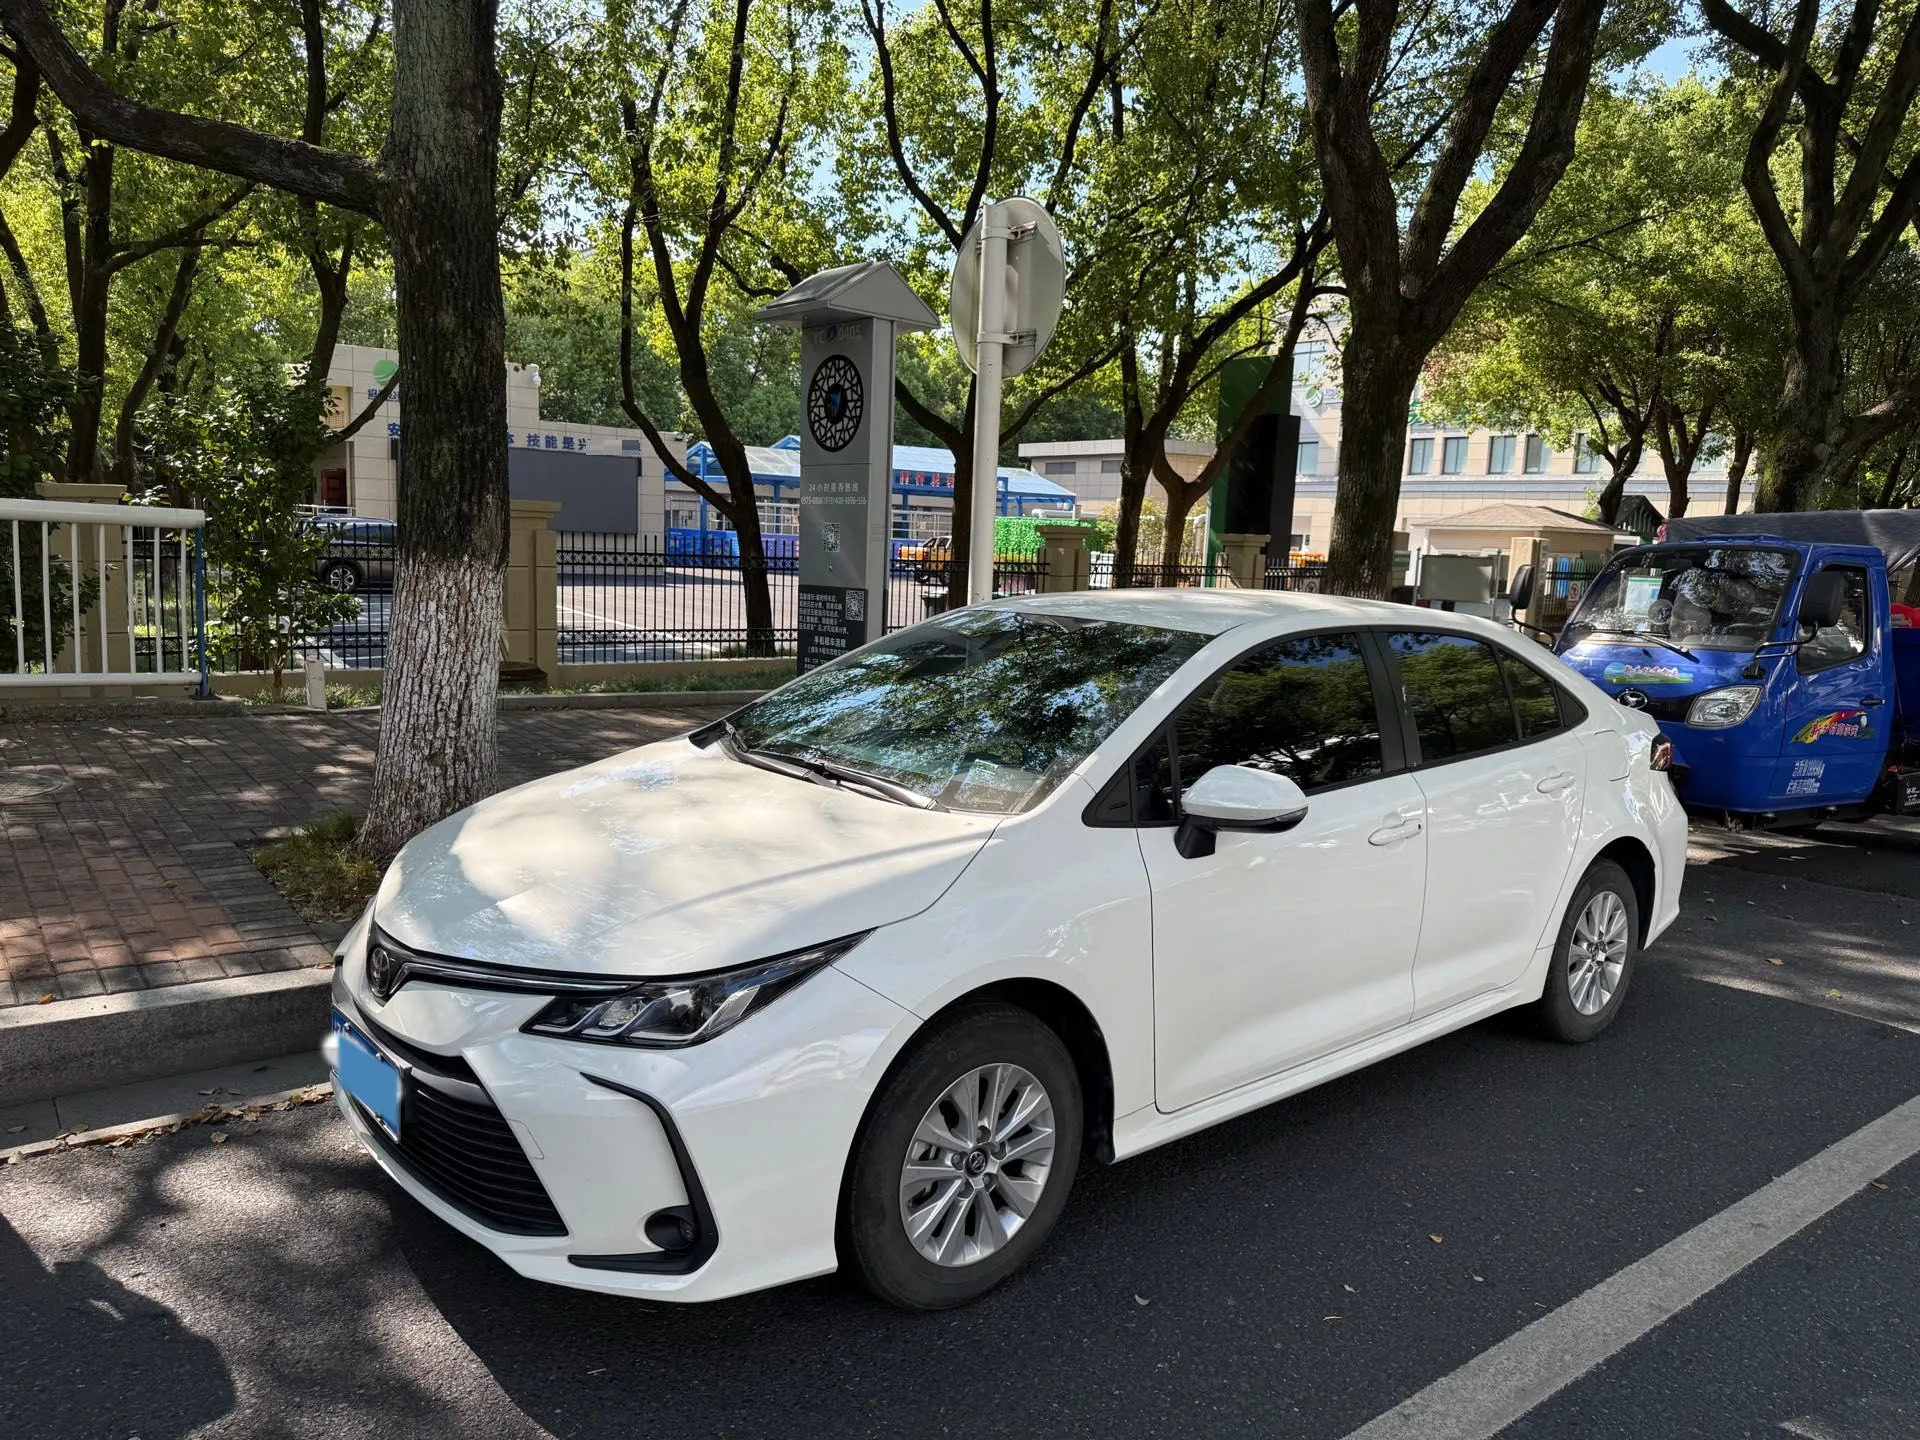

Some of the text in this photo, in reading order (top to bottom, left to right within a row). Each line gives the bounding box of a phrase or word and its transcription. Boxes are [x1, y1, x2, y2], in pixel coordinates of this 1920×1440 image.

[808, 481, 859, 492] 24小时服务热线
